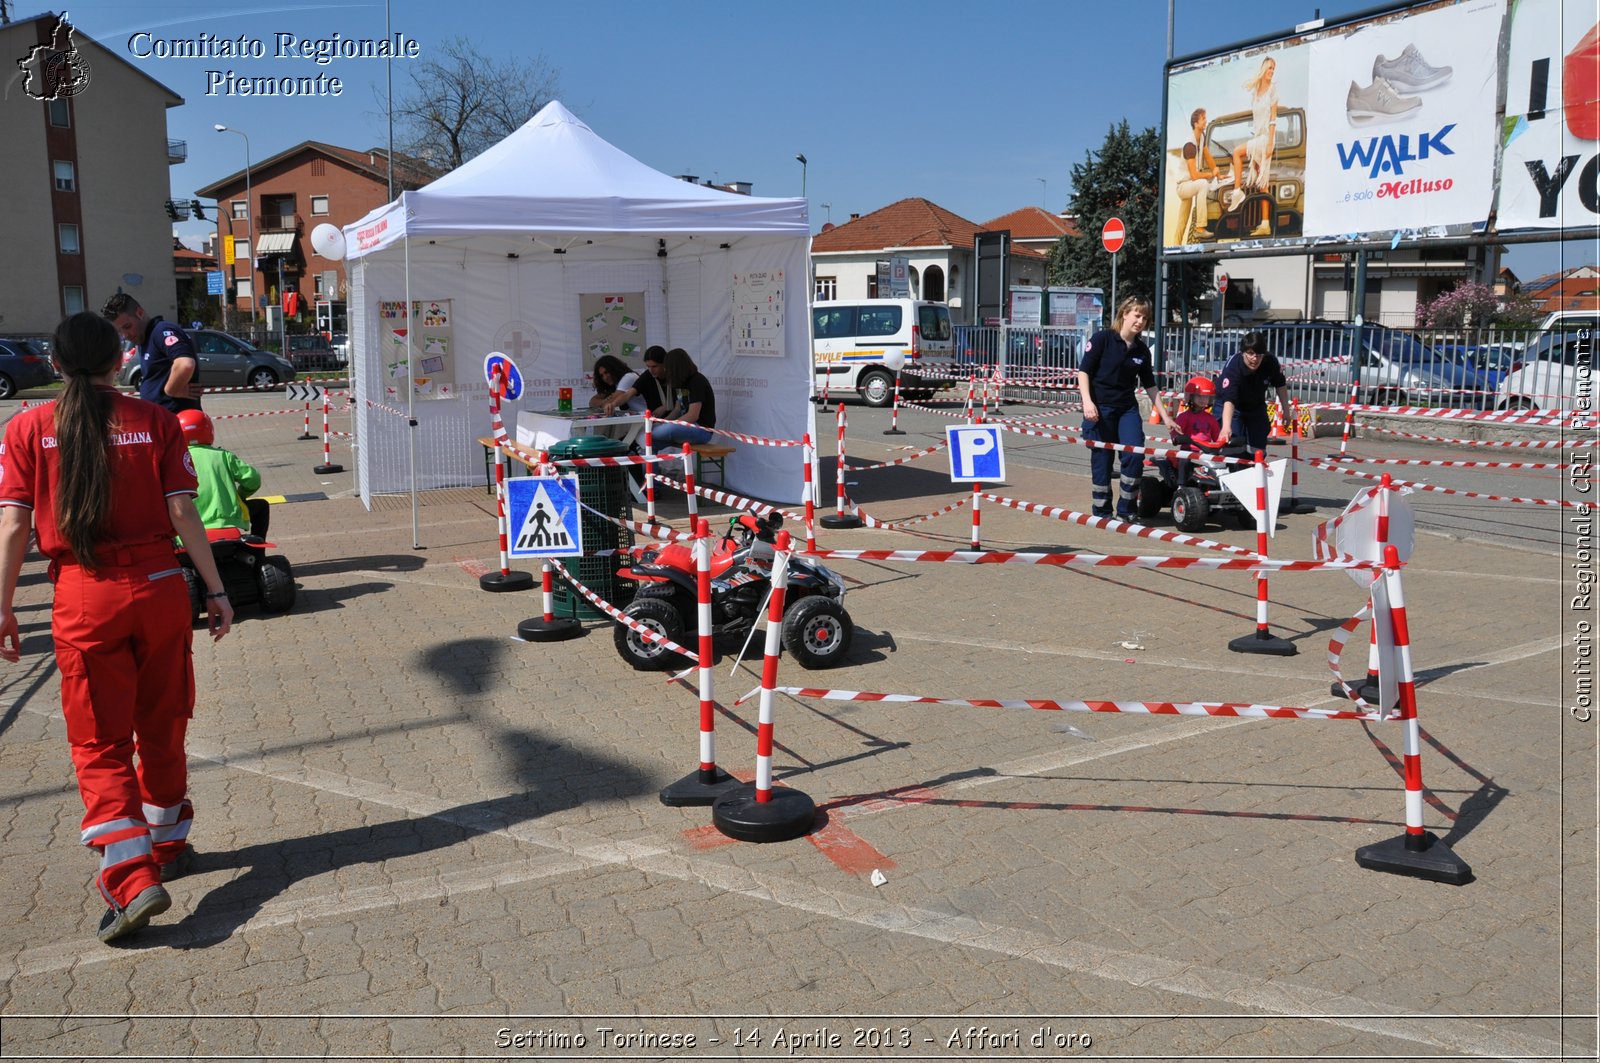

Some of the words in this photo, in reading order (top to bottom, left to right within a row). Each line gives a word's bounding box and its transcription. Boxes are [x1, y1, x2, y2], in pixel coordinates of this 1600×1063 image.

[1527, 57, 1550, 121] I
[1336, 123, 1458, 179] WALK
[1353, 189, 1373, 201] solo
[1376, 178, 1453, 199] Melluso
[958, 430, 994, 477] P
